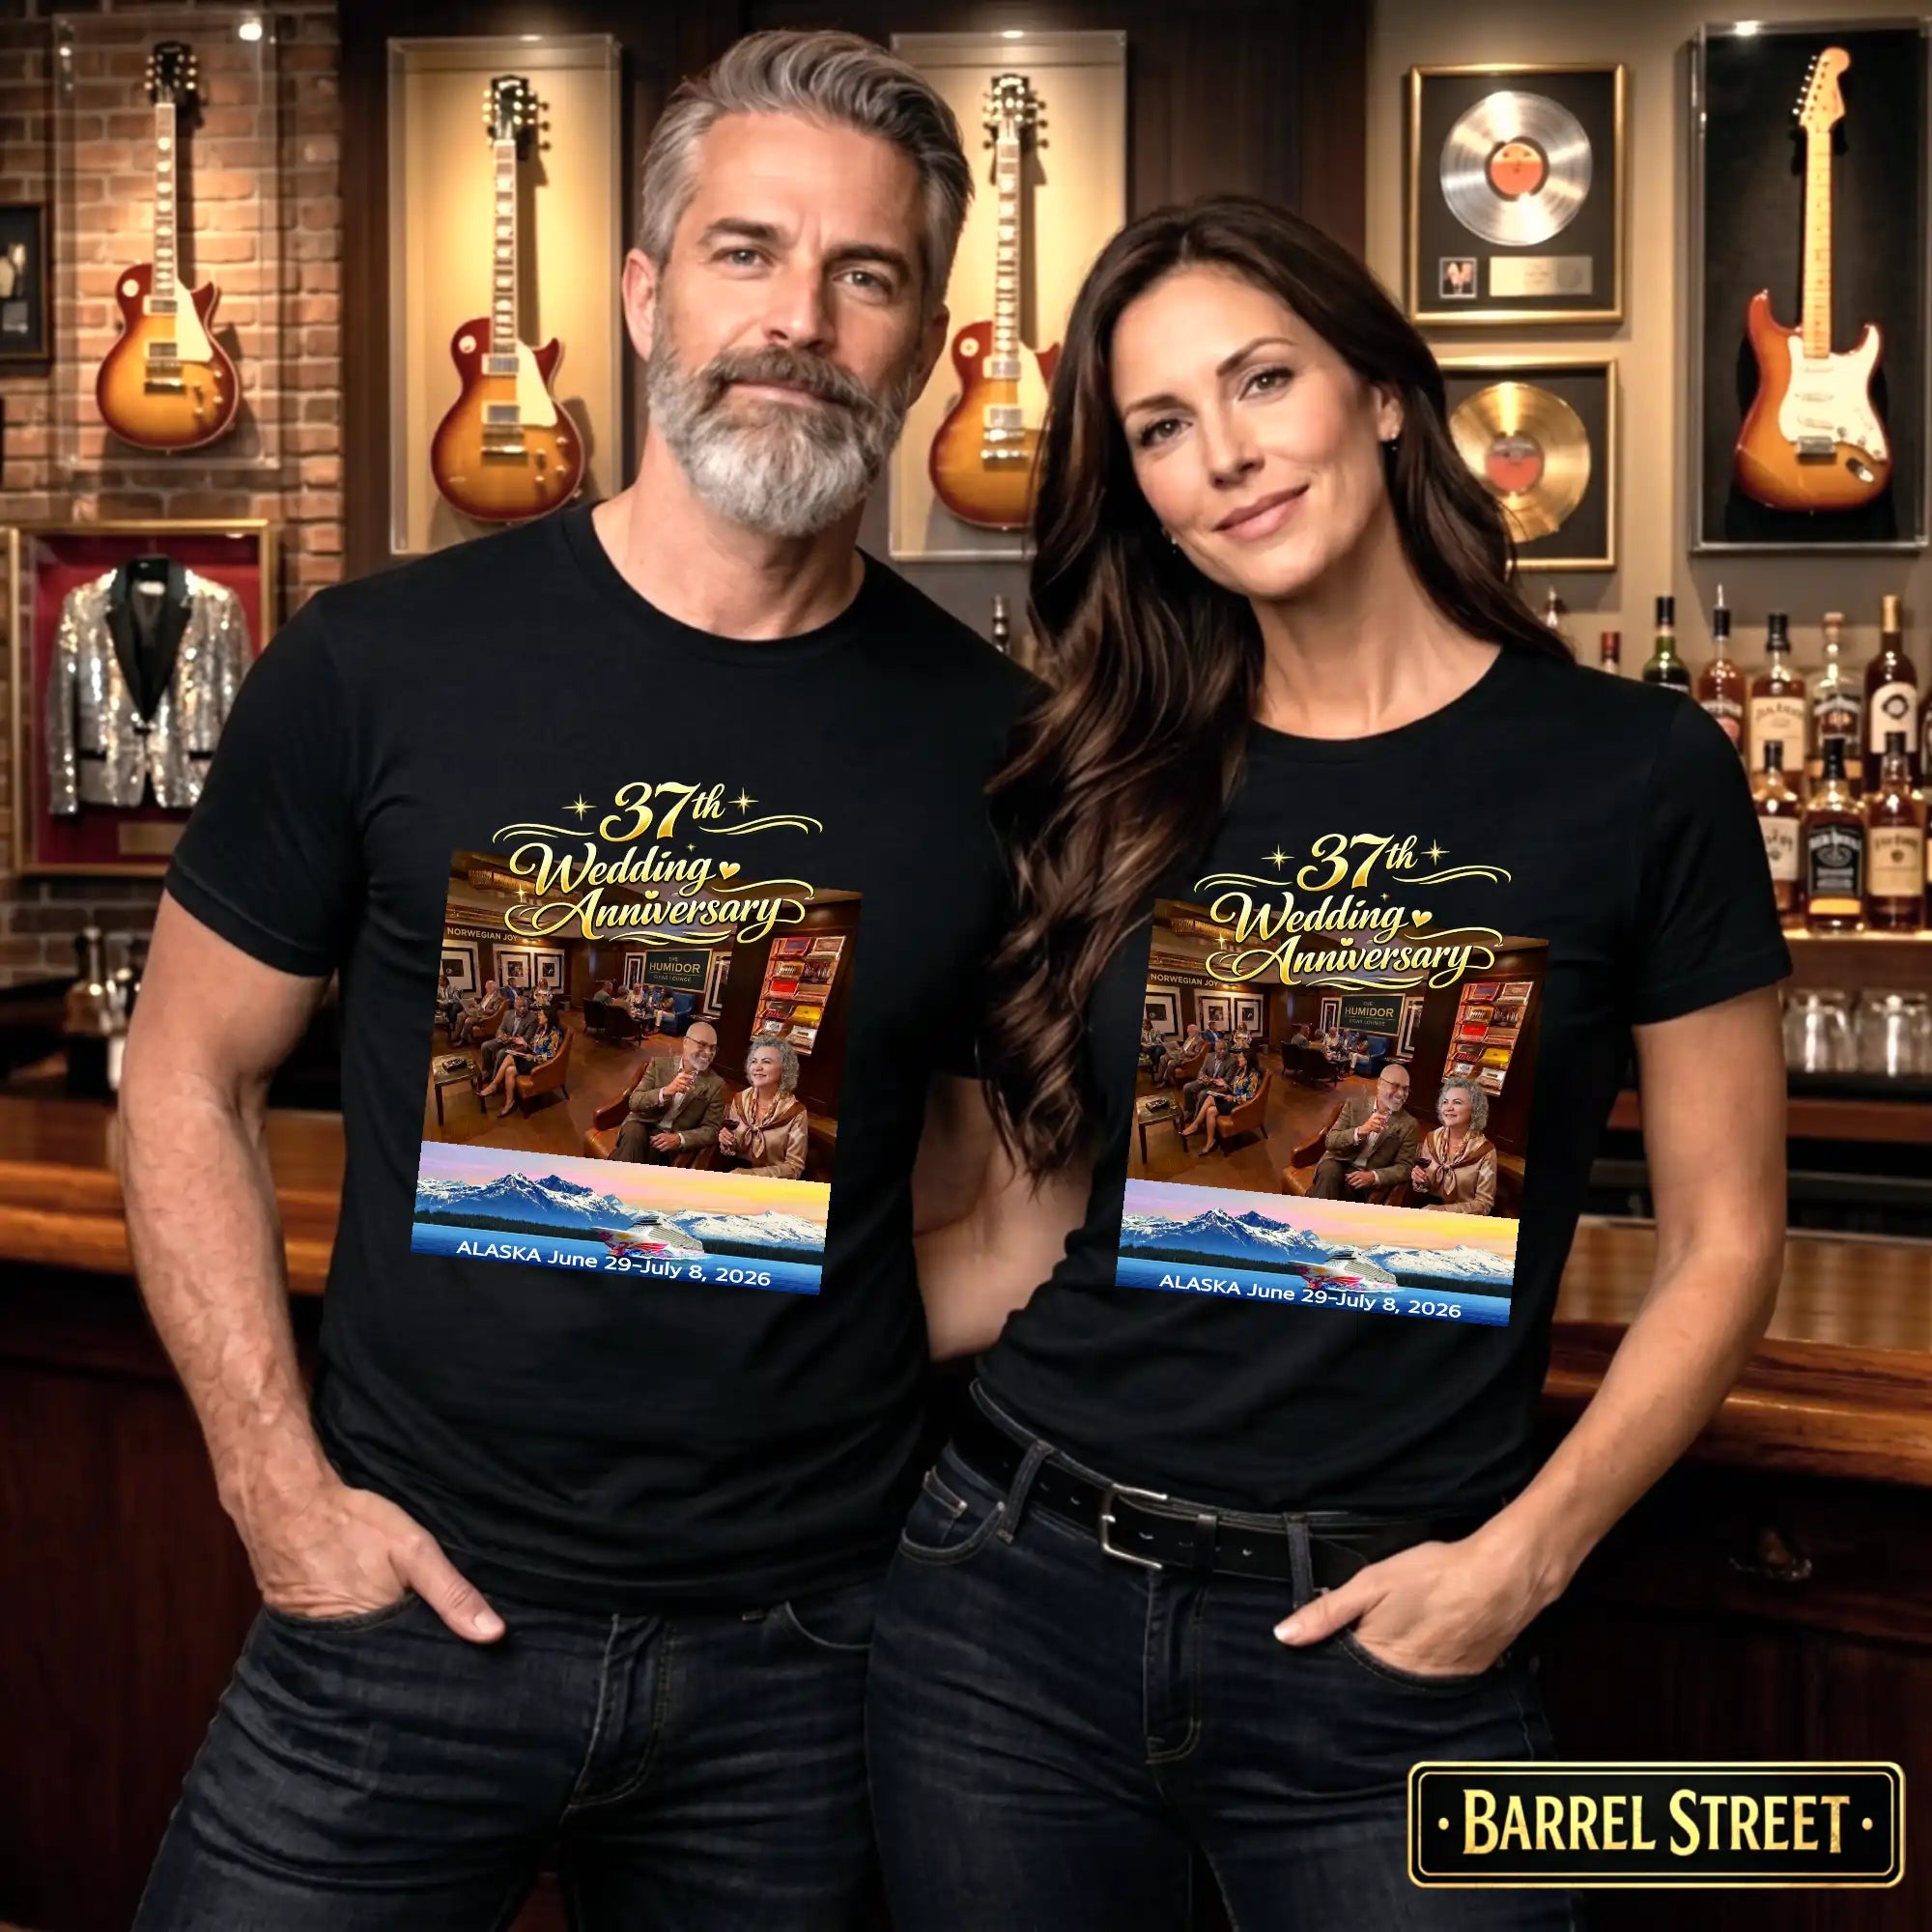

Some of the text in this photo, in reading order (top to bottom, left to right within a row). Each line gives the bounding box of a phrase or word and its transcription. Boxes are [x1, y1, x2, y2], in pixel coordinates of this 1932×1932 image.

[599, 781, 726, 842] 37th
[509, 841, 717, 897] Wedding
[1296, 832, 1418, 892] 37th
[447, 927, 501, 940] NORWEGIAN
[503, 886, 807, 945] Anniversary
[1209, 891, 1409, 945] Wedding
[649, 962, 701, 974] HUMIDOR
[1151, 973, 1203, 985] NORWEGIAN
[1205, 934, 1495, 990] Anniversary
[1345, 1007, 1394, 1018] HUMIDOR
[456, 1240, 541, 1263] ALASKA
[548, 1250, 597, 1268] June
[688, 1264, 707, 1282] 8,
[715, 1267, 771, 1287] 2026
[1159, 1274, 1241, 1295] ALASKA
[1247, 1283, 1295, 1301] June
[1383, 1297, 1400, 1314] 8,
[1407, 1299, 1462, 1319] 2026
